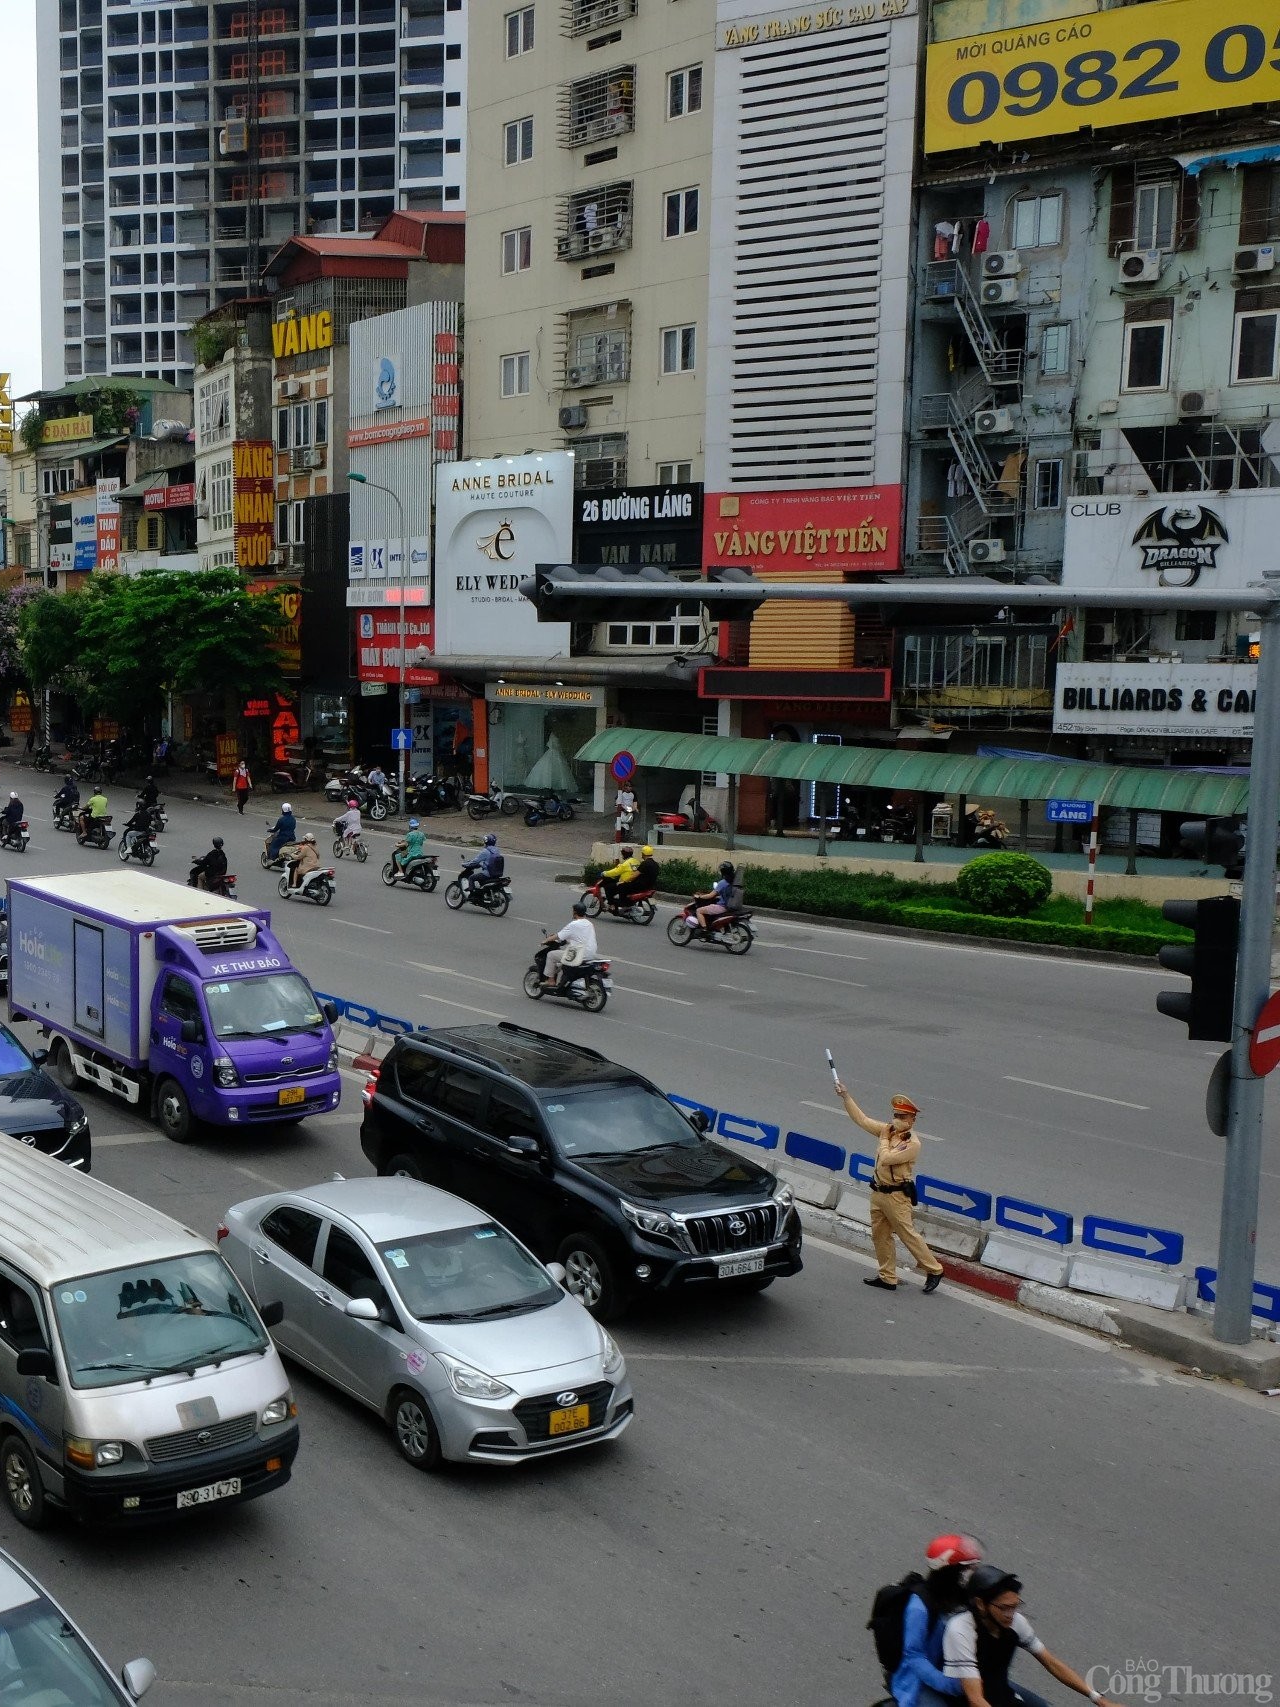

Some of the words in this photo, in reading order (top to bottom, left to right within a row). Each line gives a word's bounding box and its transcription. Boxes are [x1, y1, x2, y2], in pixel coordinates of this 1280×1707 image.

[764, 14, 812, 40] TRANG
[847, 2, 876, 23] CAO
[955, 43, 987, 61] MỜI
[991, 30, 1051, 56] QUẢNG
[1055, 23, 1093, 42] CÁO
[947, 39, 1181, 125] 0982
[1204, 24, 1280, 83] 0
[271, 308, 333, 359] VÀNG
[234, 441, 273, 478] VÀNG
[451, 475, 492, 492] ANNE
[497, 470, 555, 489] BRIDAL
[234, 480, 275, 524] NHẪN
[470, 491, 496, 501] HAUTE
[498, 489, 535, 500] COUTURE
[582, 500, 599, 522] 26
[601, 491, 650, 521] ĐƯỜNG
[653, 489, 693, 519] LÁNG
[1070, 503, 1122, 517] CLUB
[99, 518, 117, 531] THAY
[713, 524, 776, 557] VÀNG
[777, 521, 832, 561] VIỆT
[833, 515, 889, 553] TIẾN
[1144, 546, 1214, 567] DRAGON
[456, 575, 482, 591] ELY
[496, 688, 513, 697] ANNE
[515, 689, 541, 698] BRIDAL
[557, 690, 592, 701] WEDDING
[1062, 687, 1183, 712] BILLIARDS
[1191, 688, 1208, 712] &
[1056, 723, 1074, 732] 452
[1051, 808, 1088, 820] LÁNG
[211, 964, 230, 975] XE
[229, 960, 256, 972] THƯ
